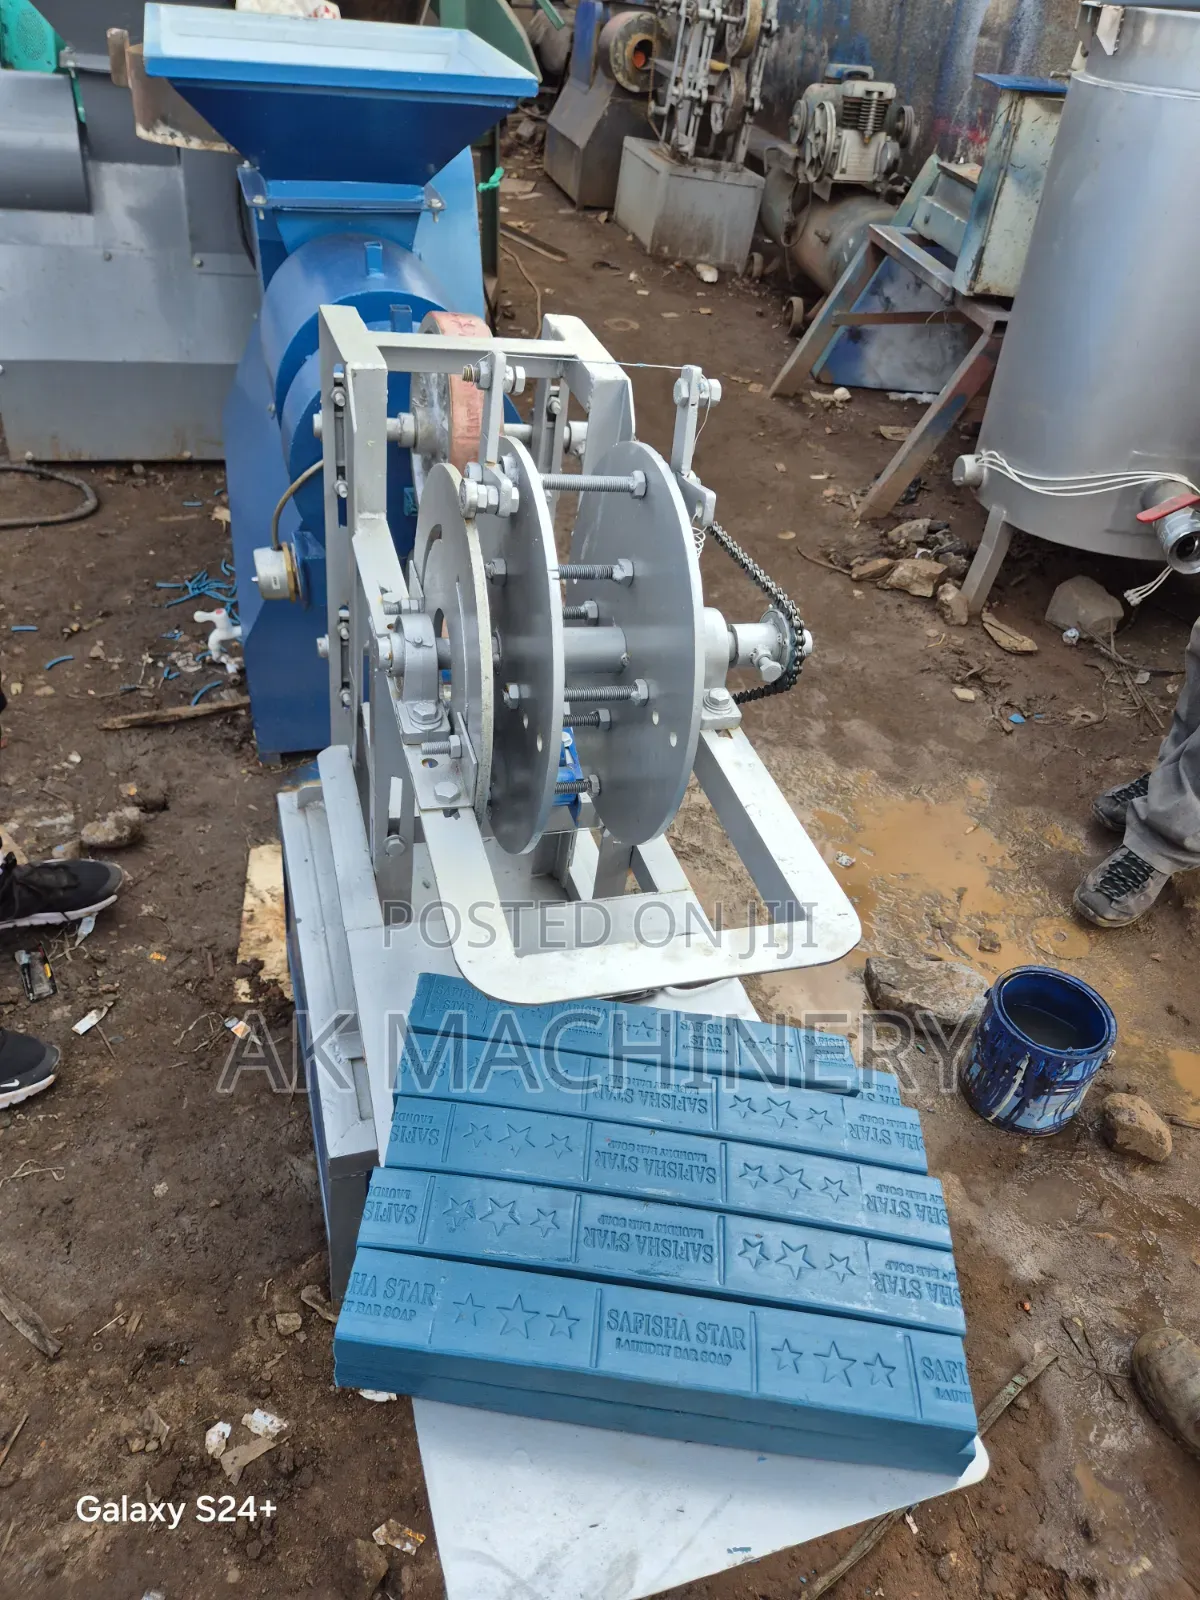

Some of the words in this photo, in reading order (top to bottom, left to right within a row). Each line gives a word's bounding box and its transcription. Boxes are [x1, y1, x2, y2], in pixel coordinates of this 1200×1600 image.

[638, 1090, 708, 1115] SAFISHA
[848, 1123, 892, 1145] STAR
[594, 1150, 639, 1173] STAR
[643, 1157, 717, 1184] SAFISHA
[865, 1194, 912, 1219] STAR
[583, 1226, 630, 1253] STAR
[635, 1234, 714, 1264] SAFISHA
[383, 1277, 436, 1306] STAR
[872, 1272, 922, 1300] STAR
[355, 1302, 382, 1317] BAR
[383, 1305, 417, 1321] SOAP
[606, 1308, 691, 1342] SAFISHA
[695, 1321, 746, 1351] STAR
[615, 1337, 672, 1357] LAUNDRY
[673, 1346, 699, 1361] BAR
[700, 1350, 733, 1366] SOAP
